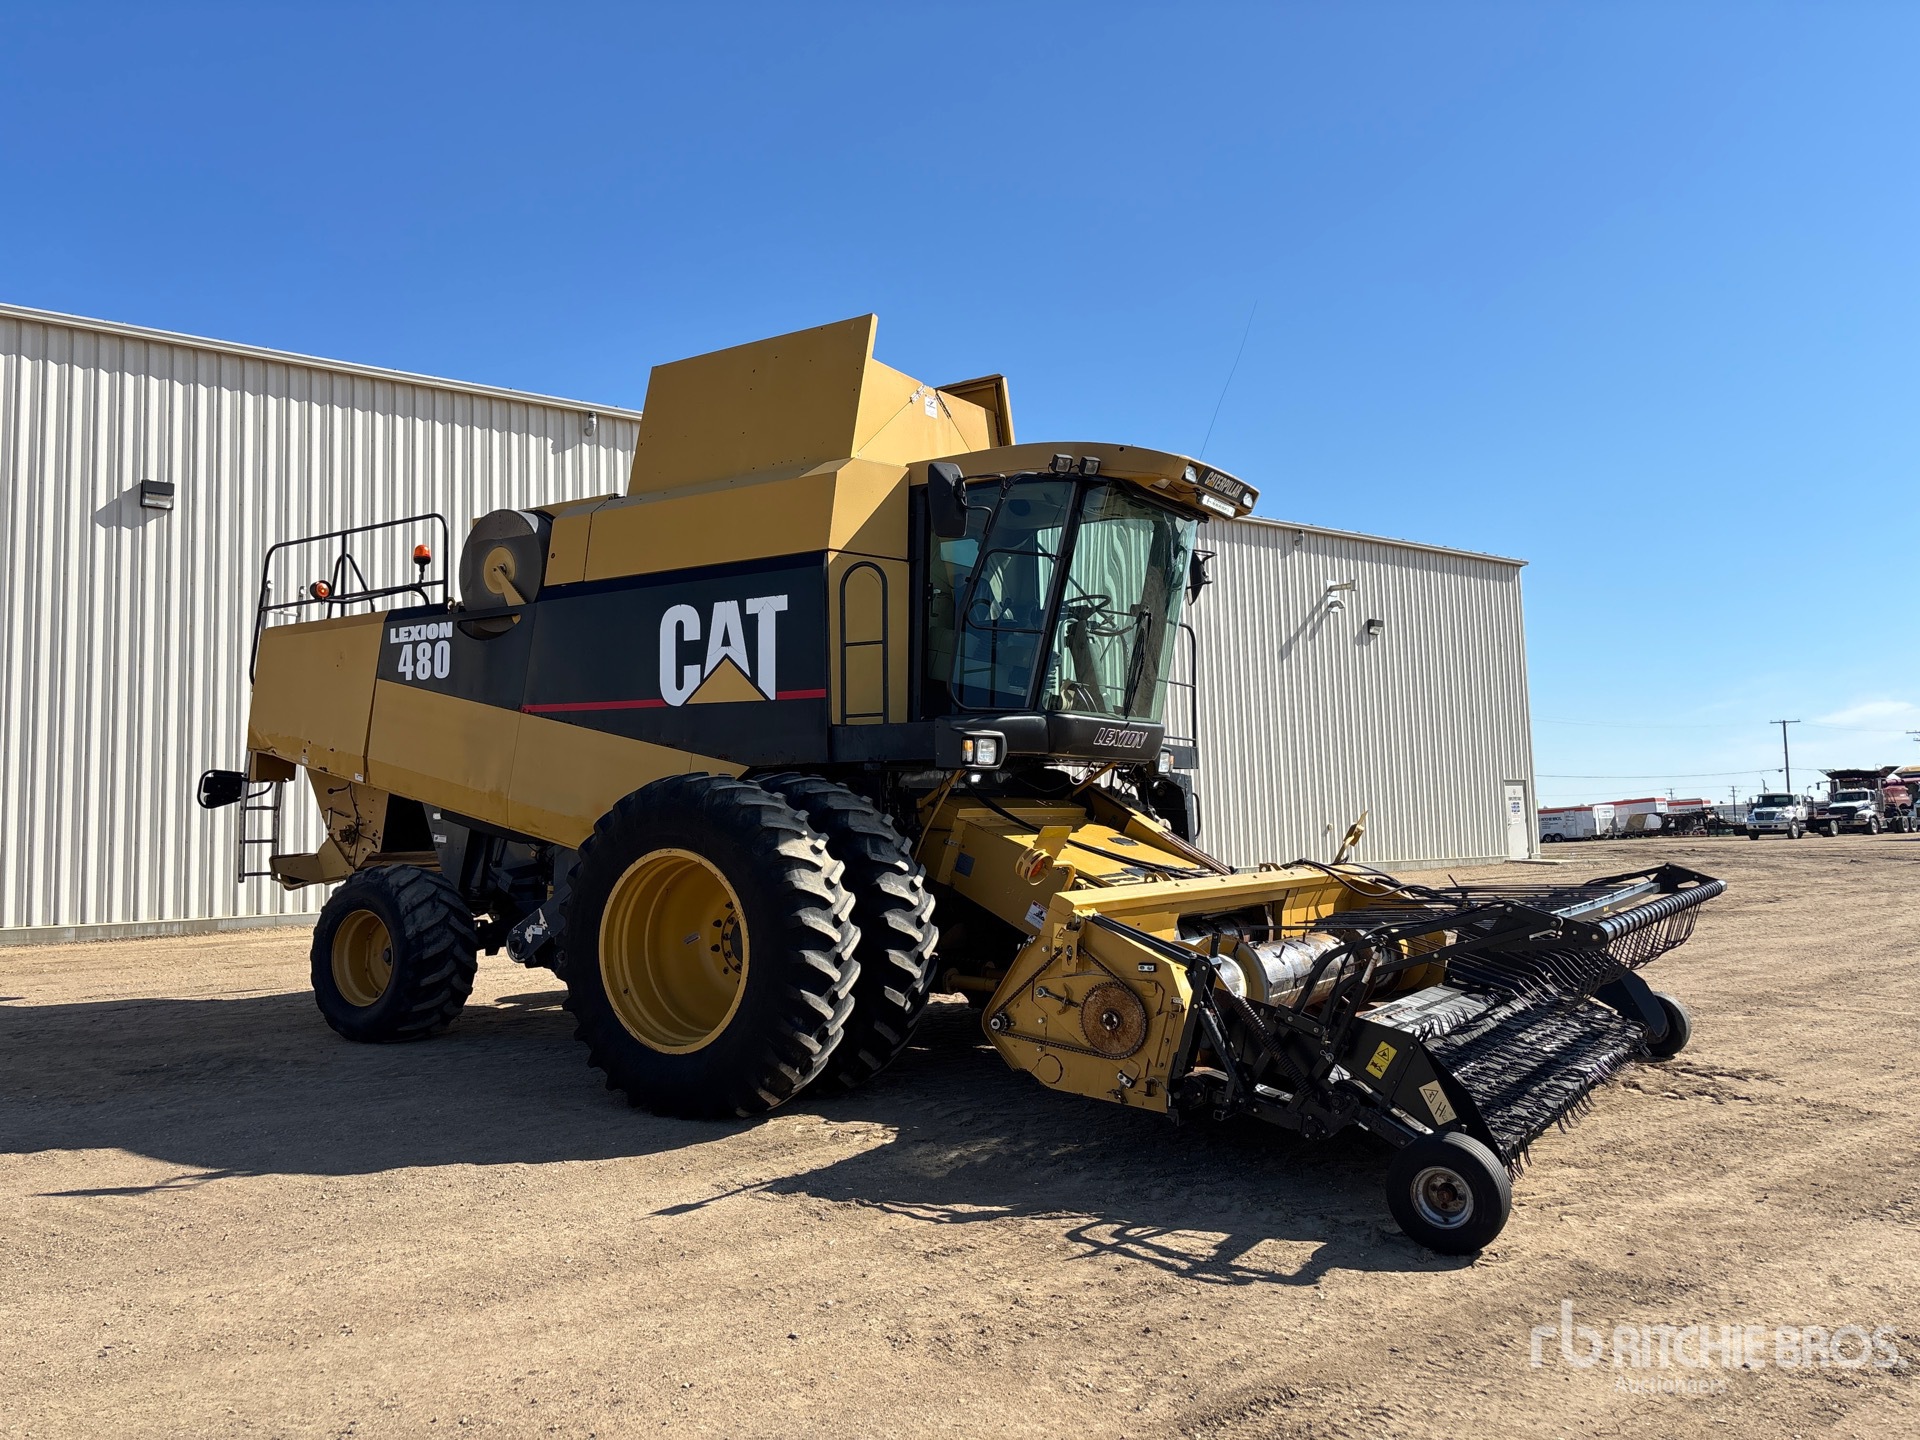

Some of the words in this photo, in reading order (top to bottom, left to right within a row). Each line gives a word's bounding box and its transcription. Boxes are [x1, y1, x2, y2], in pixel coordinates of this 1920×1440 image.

[1205, 471, 1244, 499] CATERPILLAR
[390, 621, 453, 643] LEXION
[398, 640, 451, 681] 480
[660, 594, 788, 706] CAT
[1093, 727, 1148, 748] LEXION
